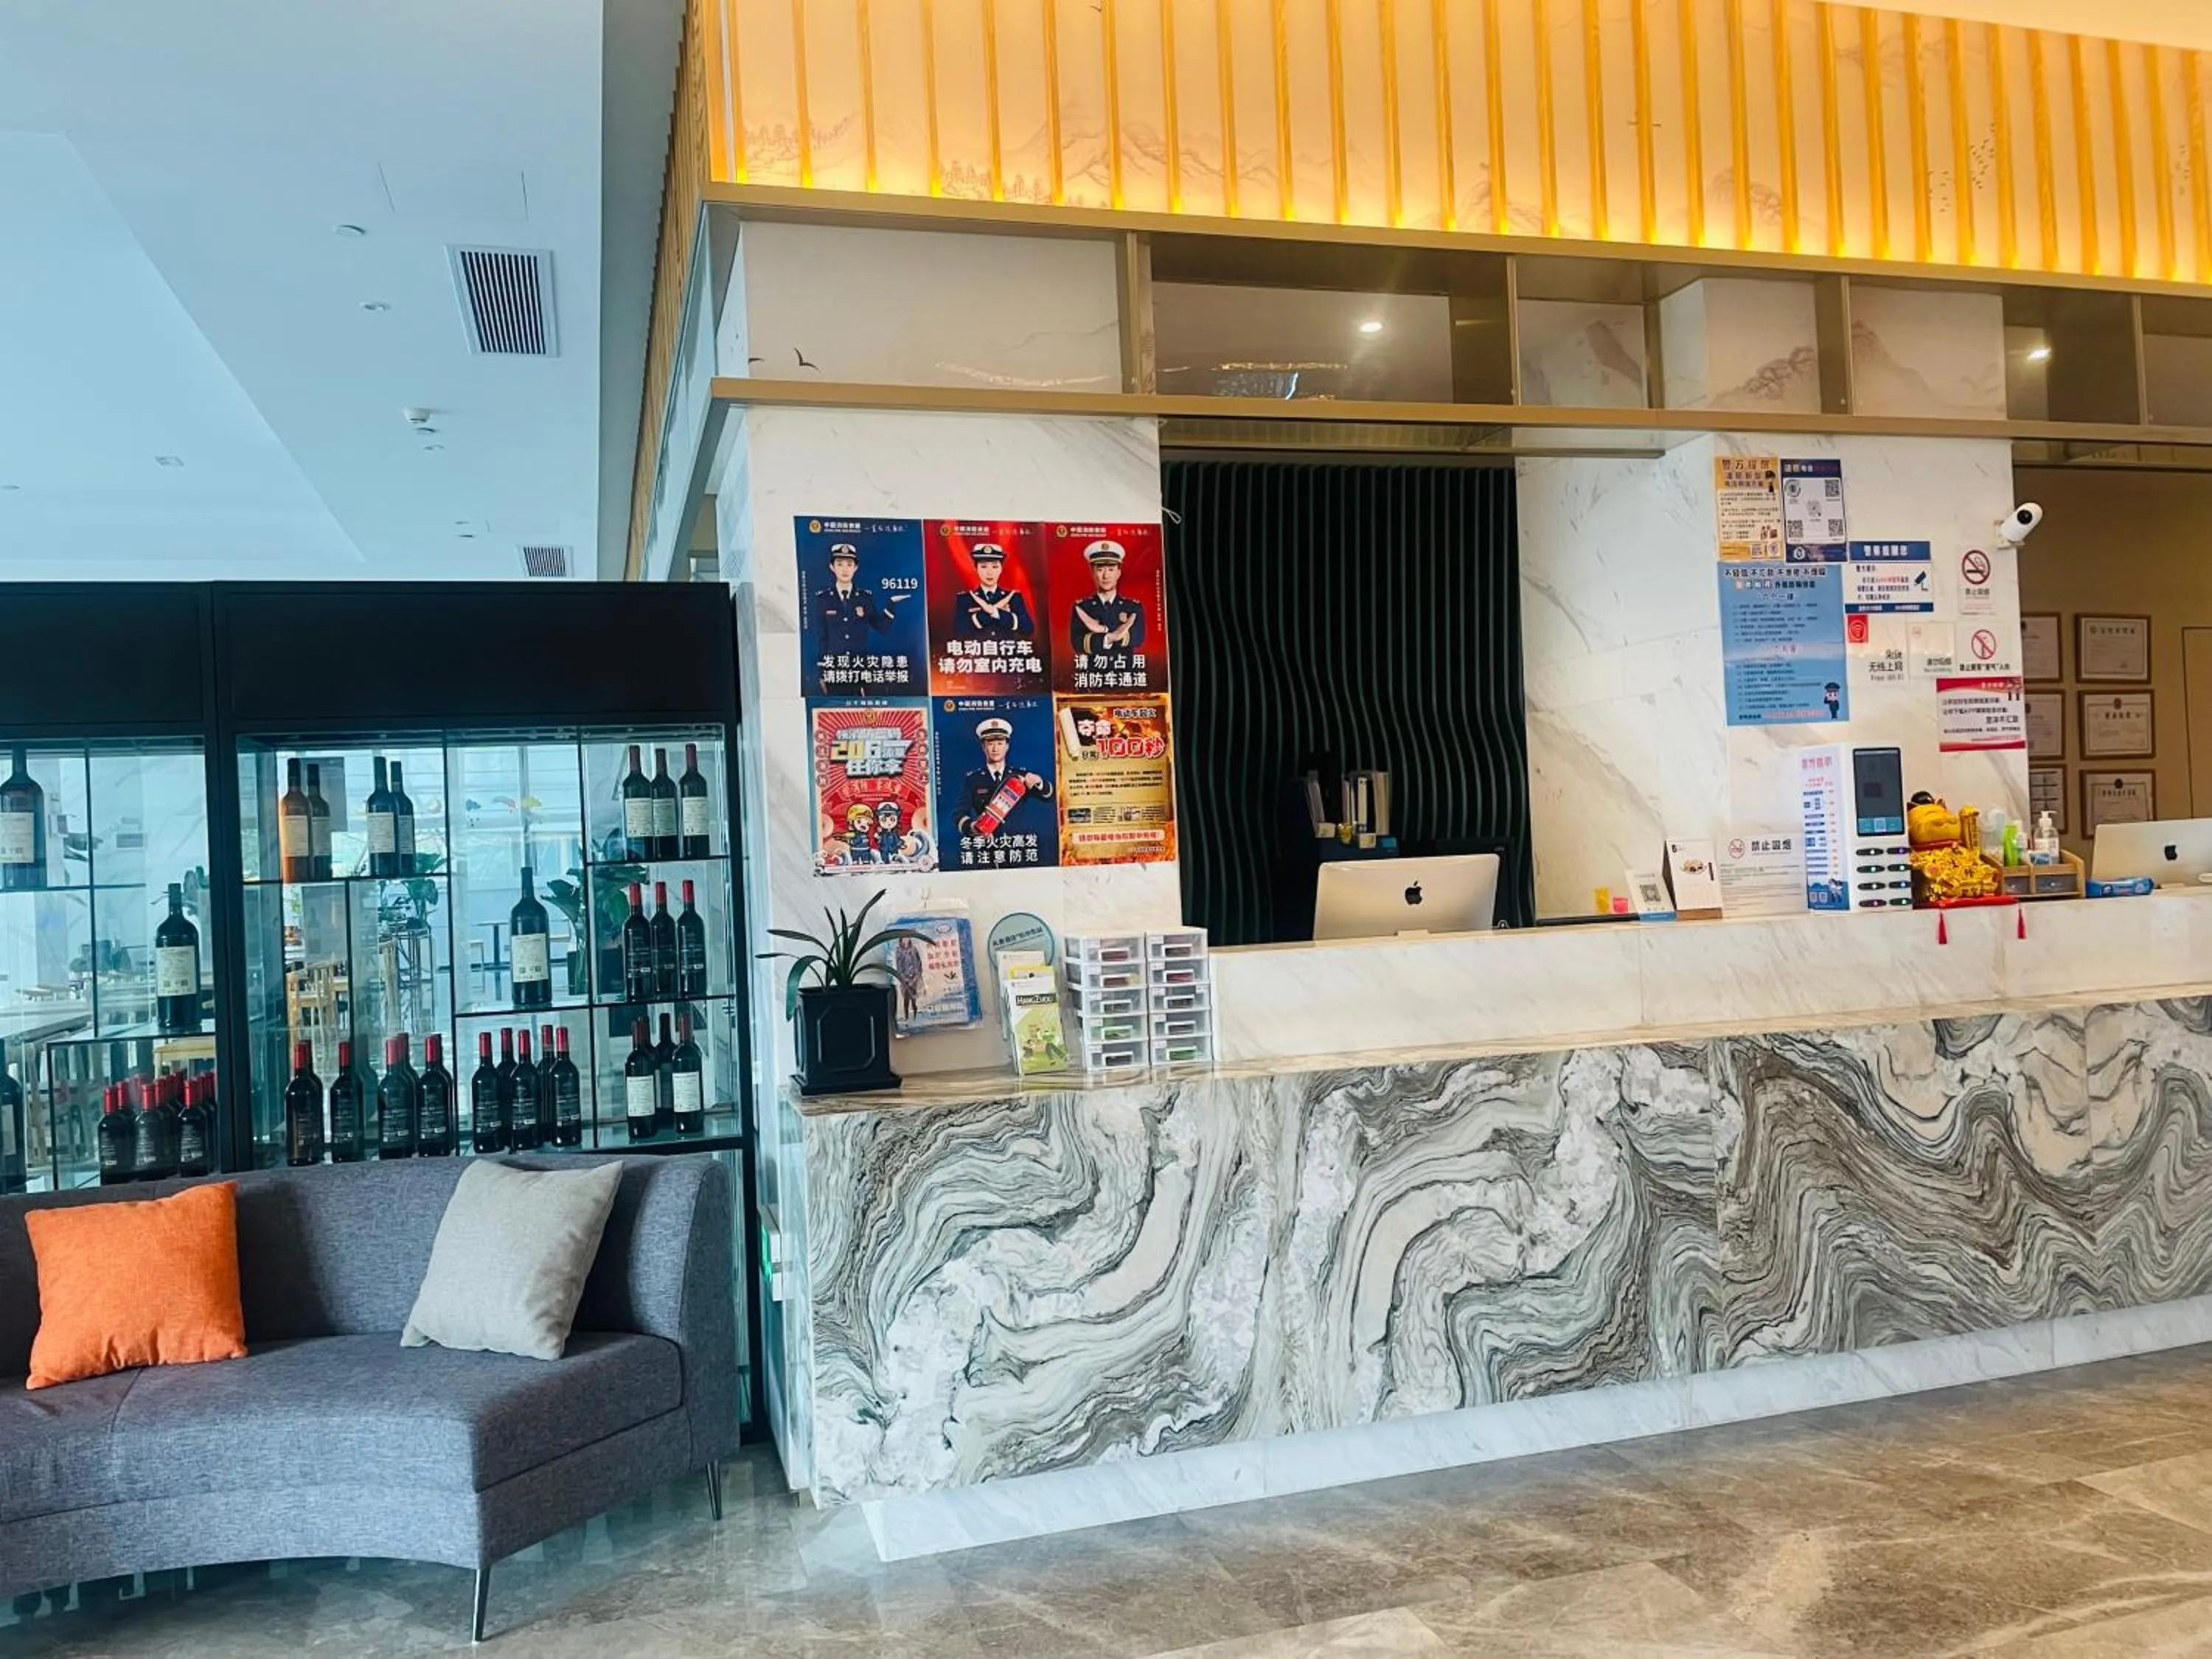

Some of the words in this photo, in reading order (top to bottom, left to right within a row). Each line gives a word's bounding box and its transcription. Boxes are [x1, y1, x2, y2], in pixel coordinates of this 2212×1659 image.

[881, 577, 918, 589] 96119
[946, 639, 1034, 655] 电动自行车
[823, 654, 909, 668] 发现火灾隐患
[938, 657, 1043, 673] 请勿室内充电
[1074, 653, 1145, 669] 请勿占用
[1868, 661, 1903, 672] 无线上网
[823, 669, 909, 684] 请拨打电话举报
[1074, 670, 1147, 688] 消防车通道
[1077, 719, 1111, 737] 夺命
[959, 832, 1038, 850] 冬季火灾高发
[961, 849, 1039, 865] 请注意防范
